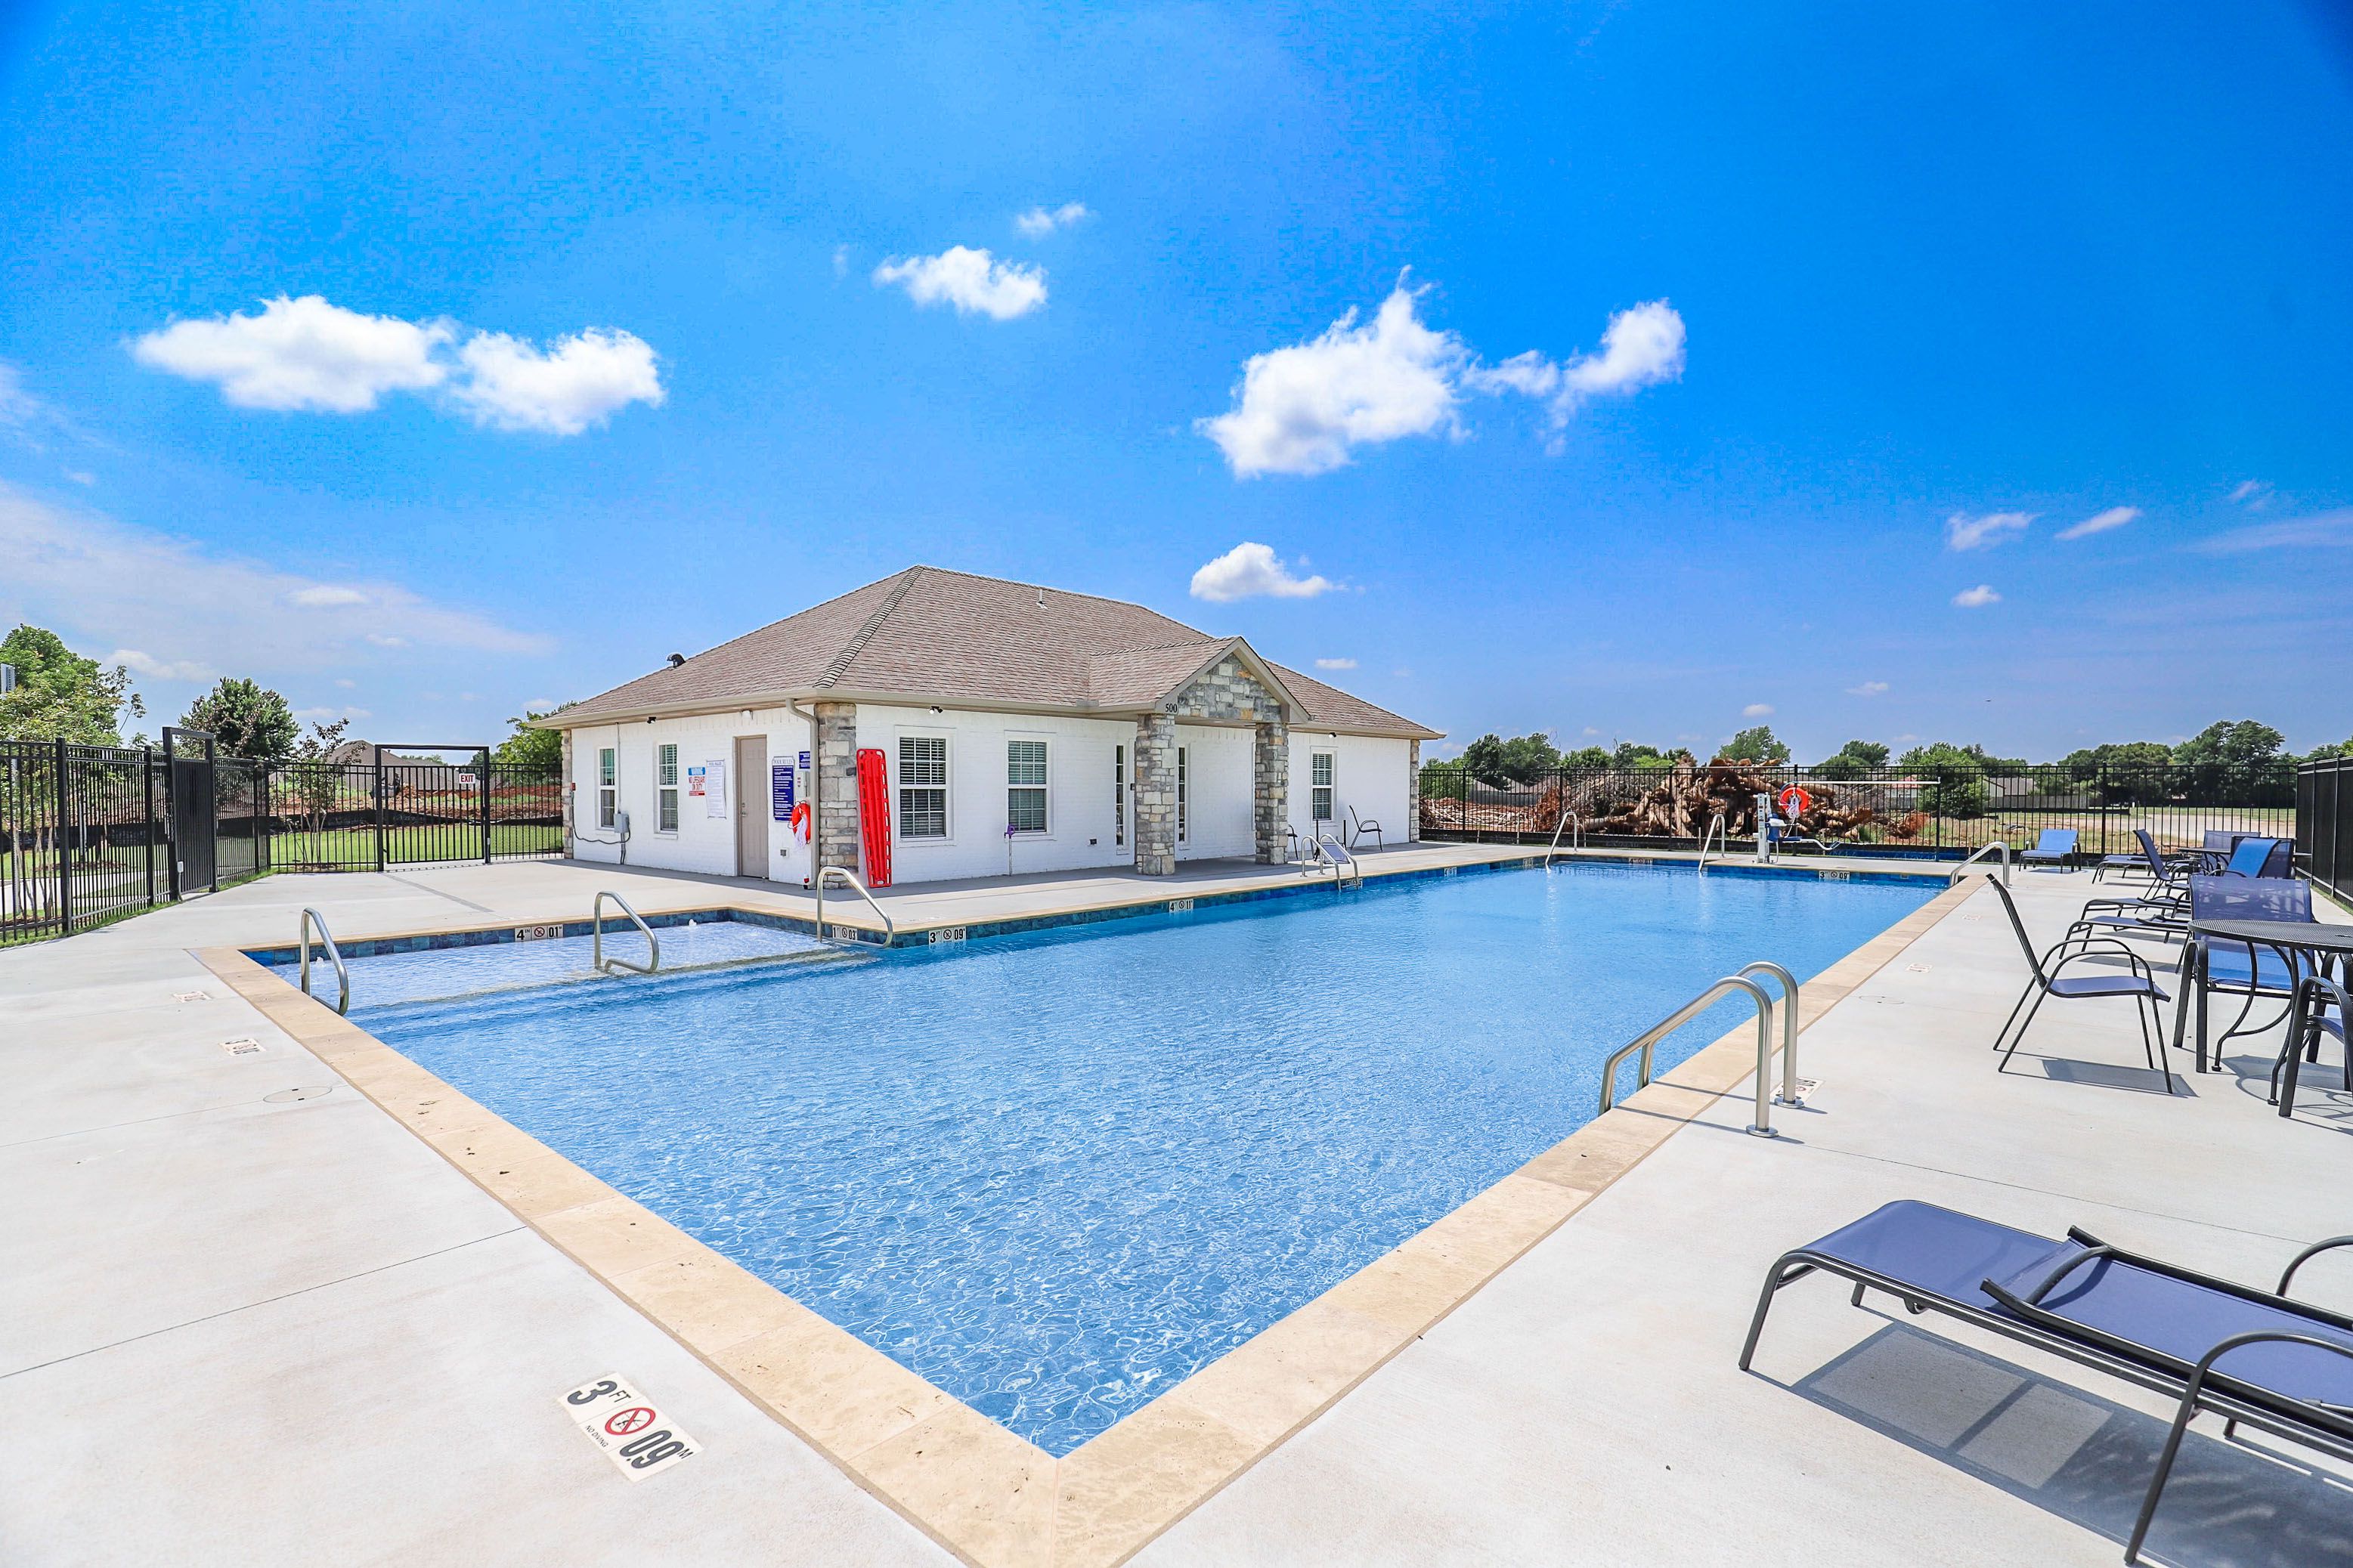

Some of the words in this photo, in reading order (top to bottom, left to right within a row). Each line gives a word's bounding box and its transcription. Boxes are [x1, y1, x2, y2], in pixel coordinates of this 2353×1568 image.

[1166, 704, 1177, 713] 500
[1170, 902, 1175, 911] 4
[516, 929, 525, 940] 4
[930, 932, 937, 943] 3
[567, 1381, 618, 1406] 3
[608, 1390, 631, 1403] FT
[591, 1431, 608, 1448] DIVING
[676, 1448, 694, 1459] M
